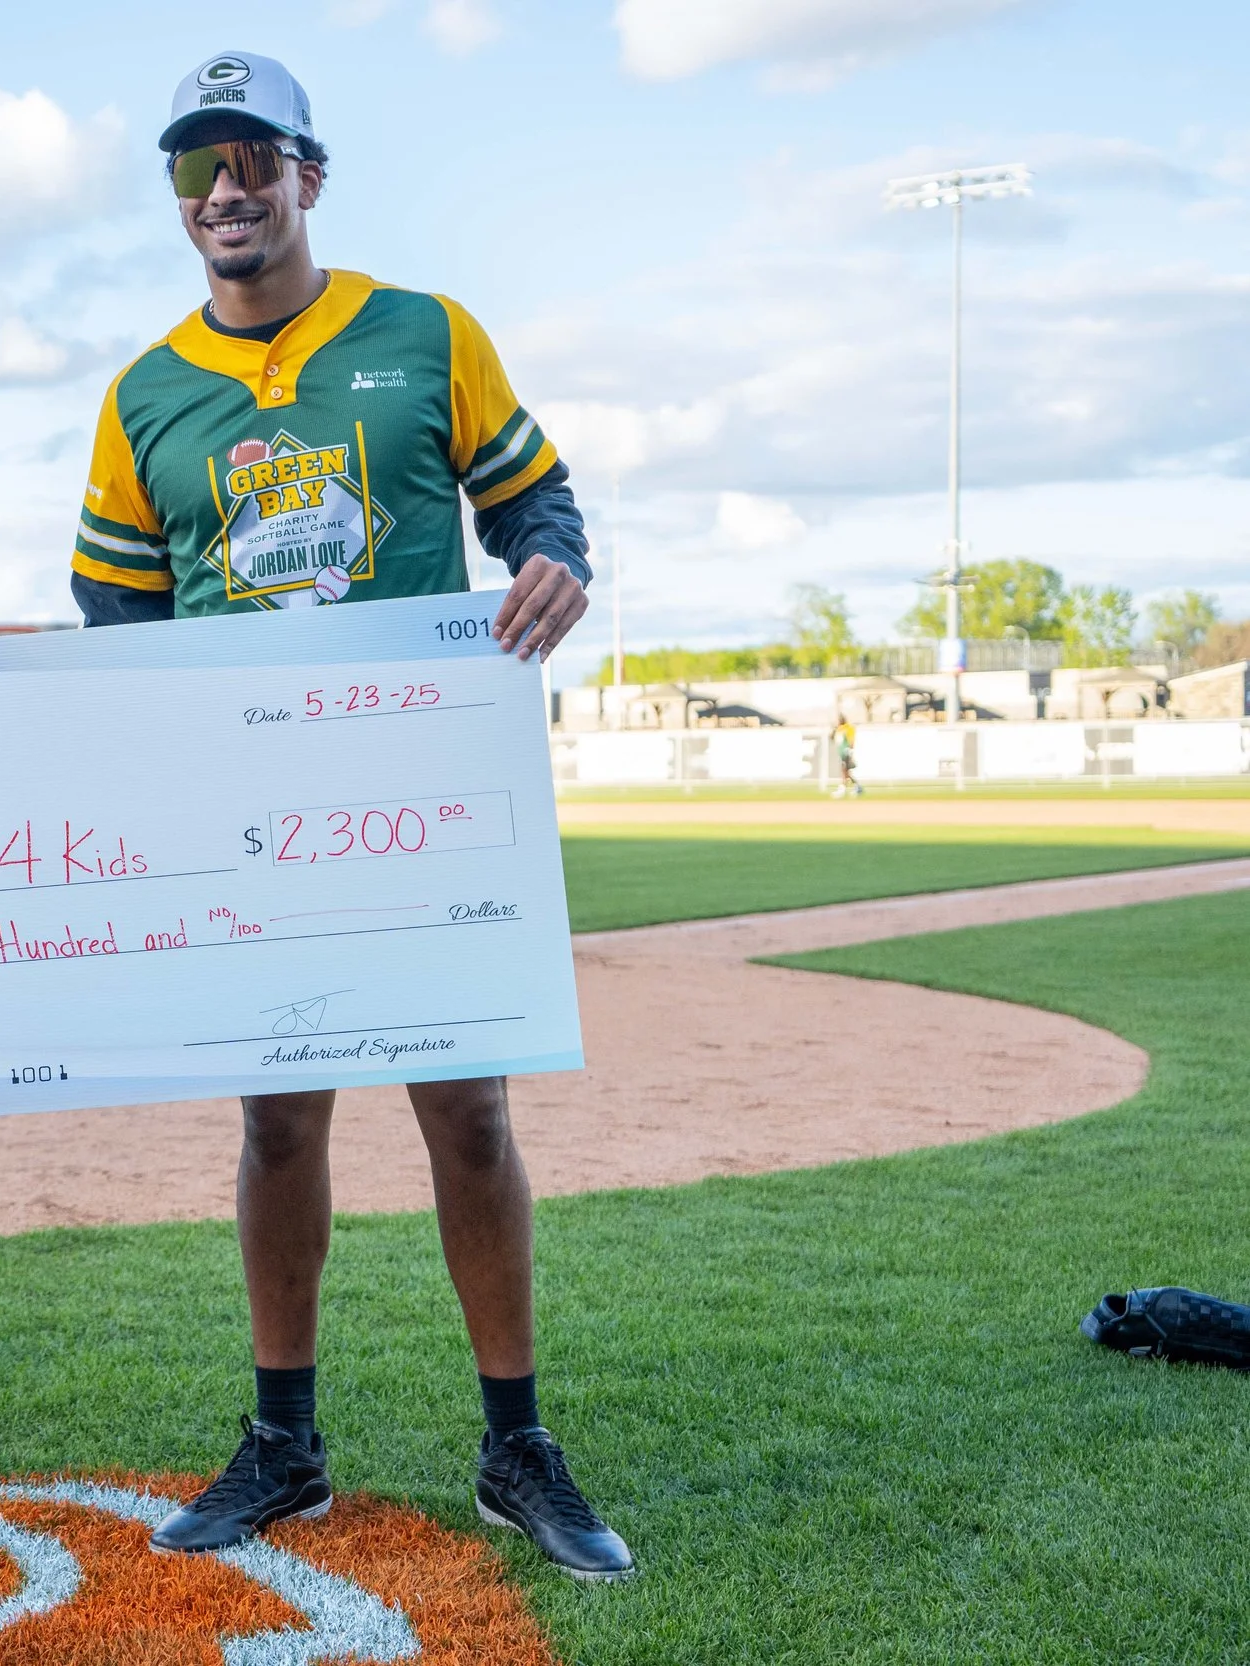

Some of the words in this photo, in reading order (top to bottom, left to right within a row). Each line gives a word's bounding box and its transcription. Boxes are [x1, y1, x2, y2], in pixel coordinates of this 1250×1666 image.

[199, 89, 246, 108] PACKERS
[363, 368, 405, 379] network
[375, 379, 407, 388] health
[227, 446, 348, 497] GREEN
[254, 478, 328, 521] BAY
[247, 526, 307, 546] SOFTBALL
[310, 520, 347, 532] GAME
[268, 513, 320, 530] CHARITY
[276, 539, 303, 548] HOSTED
[248, 545, 308, 580] JORDAN
[310, 540, 348, 569] LOVE
[435, 618, 491, 642] 1001
[305, 683, 441, 716] 5-23-25
[244, 707, 293, 726] Date
[62, 820, 148, 884] Kids
[244, 825, 263, 857] $
[448, 900, 518, 921] Dollars
[144, 918, 188, 951] and
[260, 1039, 368, 1067] Authorized
[368, 1037, 457, 1064] Signature
[11, 1064, 69, 1085] 1001
